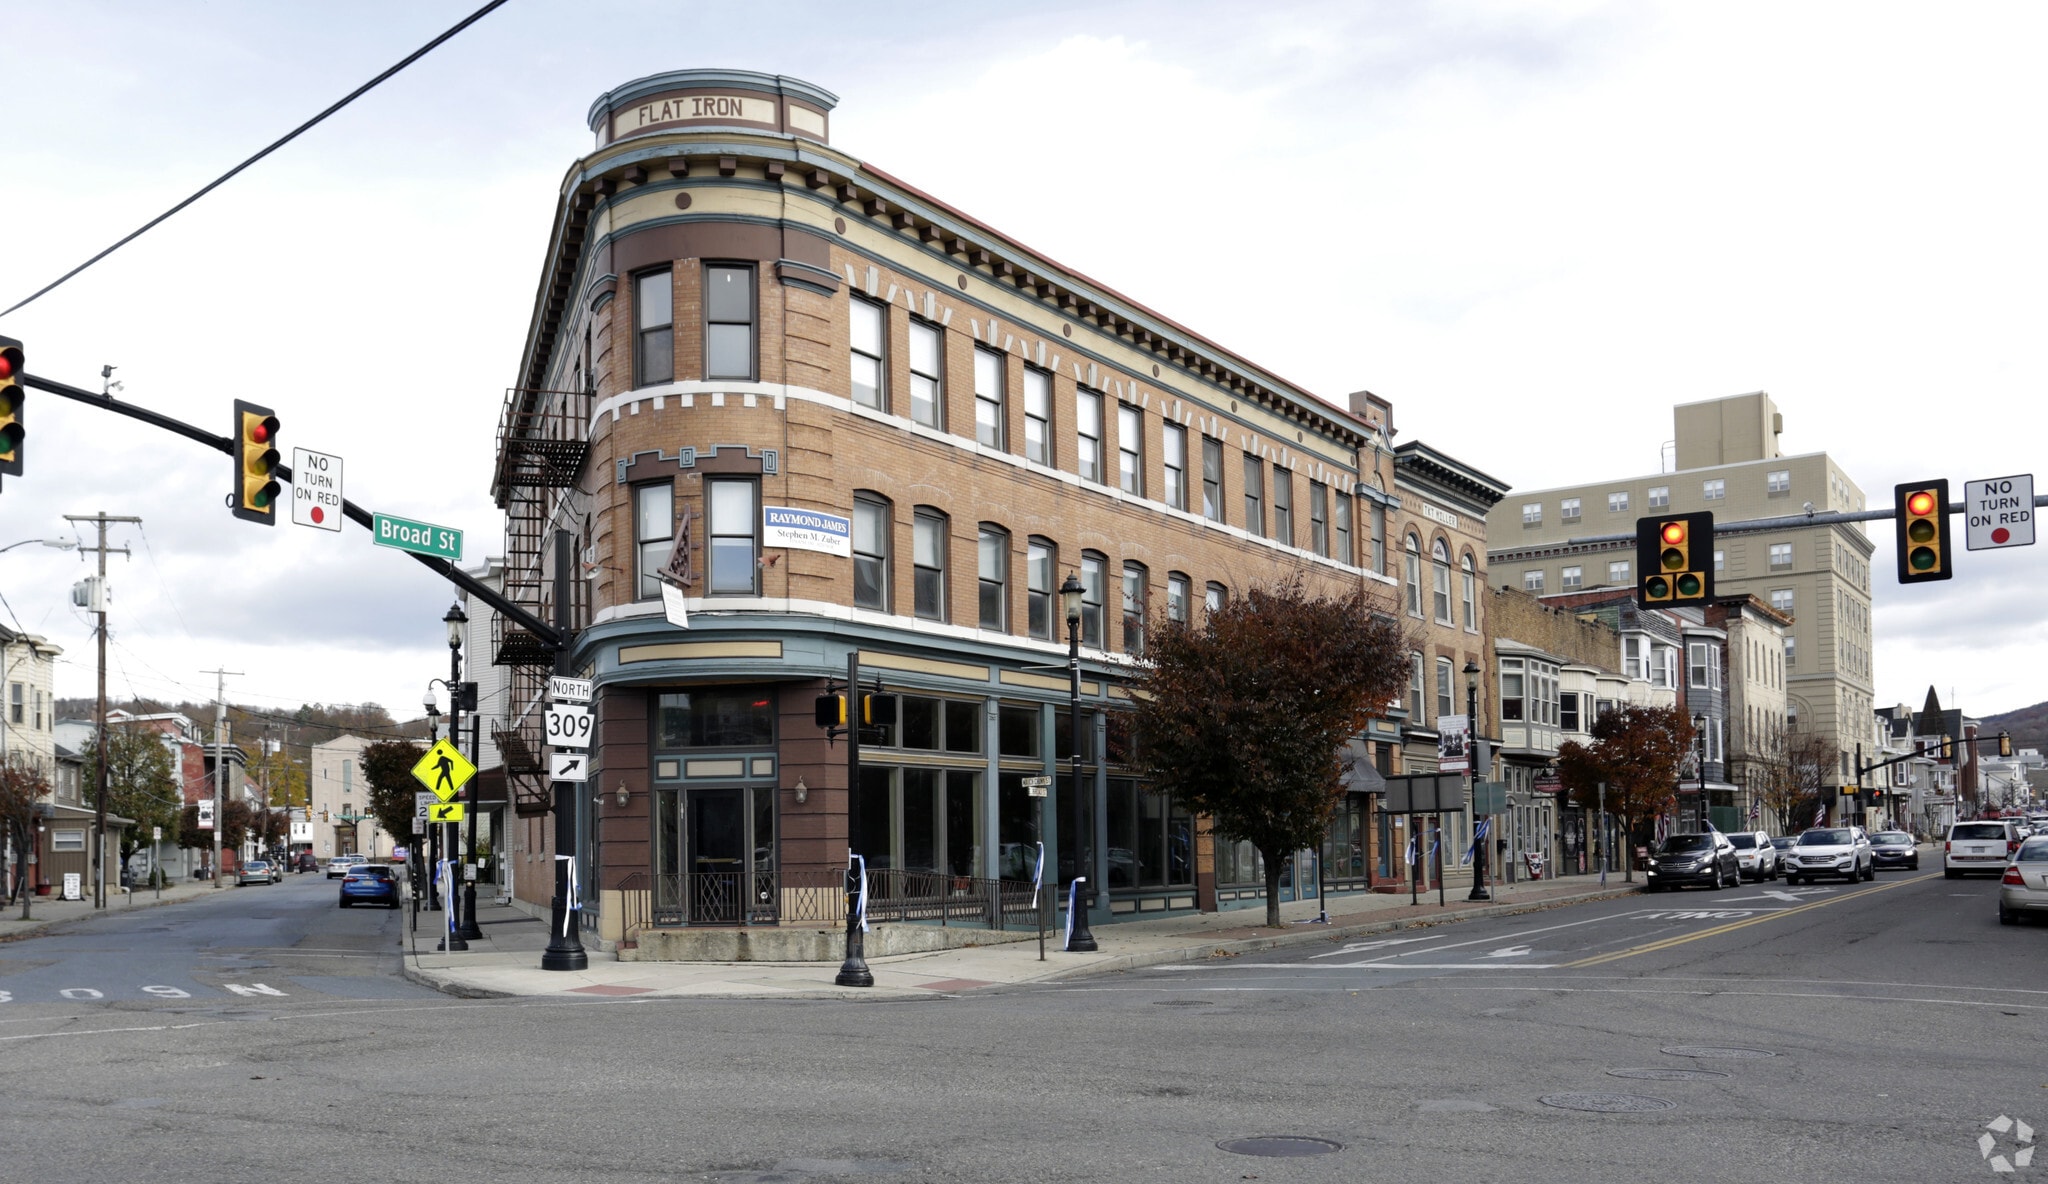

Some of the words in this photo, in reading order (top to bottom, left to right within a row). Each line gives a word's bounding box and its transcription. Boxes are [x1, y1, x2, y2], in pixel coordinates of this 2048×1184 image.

[639, 99, 684, 126] FLAT
[692, 98, 742, 117] IRON
[308, 455, 328, 471] NO
[304, 472, 333, 488] TURN
[1985, 481, 2011, 495] NO
[296, 487, 312, 501] ON
[317, 491, 339, 506] RED
[1980, 496, 2019, 511] TURN
[770, 512, 821, 527] RAYMOND
[821, 519, 846, 533] JAMES
[1970, 514, 1991, 527] ON
[2000, 510, 2030, 524] RED
[381, 519, 431, 546] Broad
[439, 531, 456, 551] St
[777, 529, 808, 540] Stephen
[809, 532, 820, 542] M.
[821, 534, 841, 546] Zuber
[553, 679, 589, 697] NORTH
[548, 713, 590, 738] 309
[419, 806, 427, 817] 2
